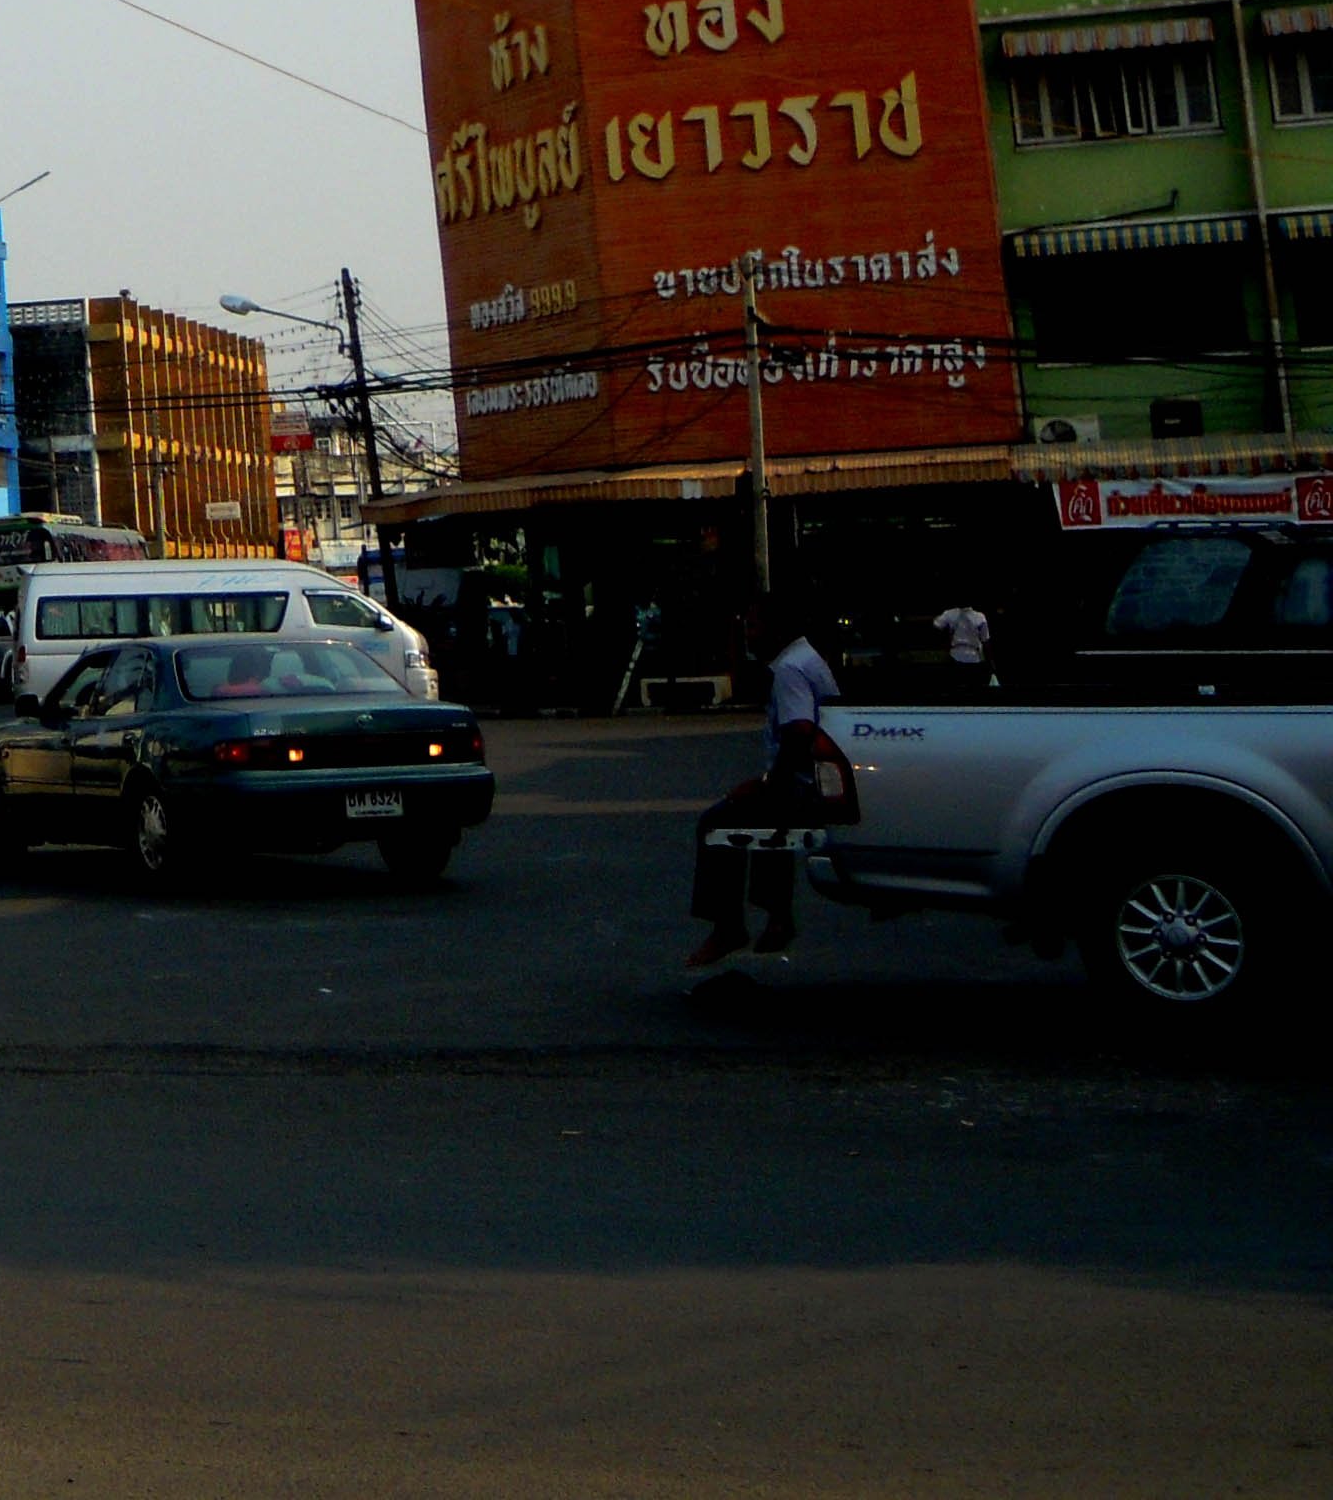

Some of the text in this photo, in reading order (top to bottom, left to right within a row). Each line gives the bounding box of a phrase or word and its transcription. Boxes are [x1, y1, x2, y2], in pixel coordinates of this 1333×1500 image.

[489, 10, 549, 92] ห้าง
[605, 70, 923, 182] เยาวราช
[530, 280, 577, 318] 999.9
